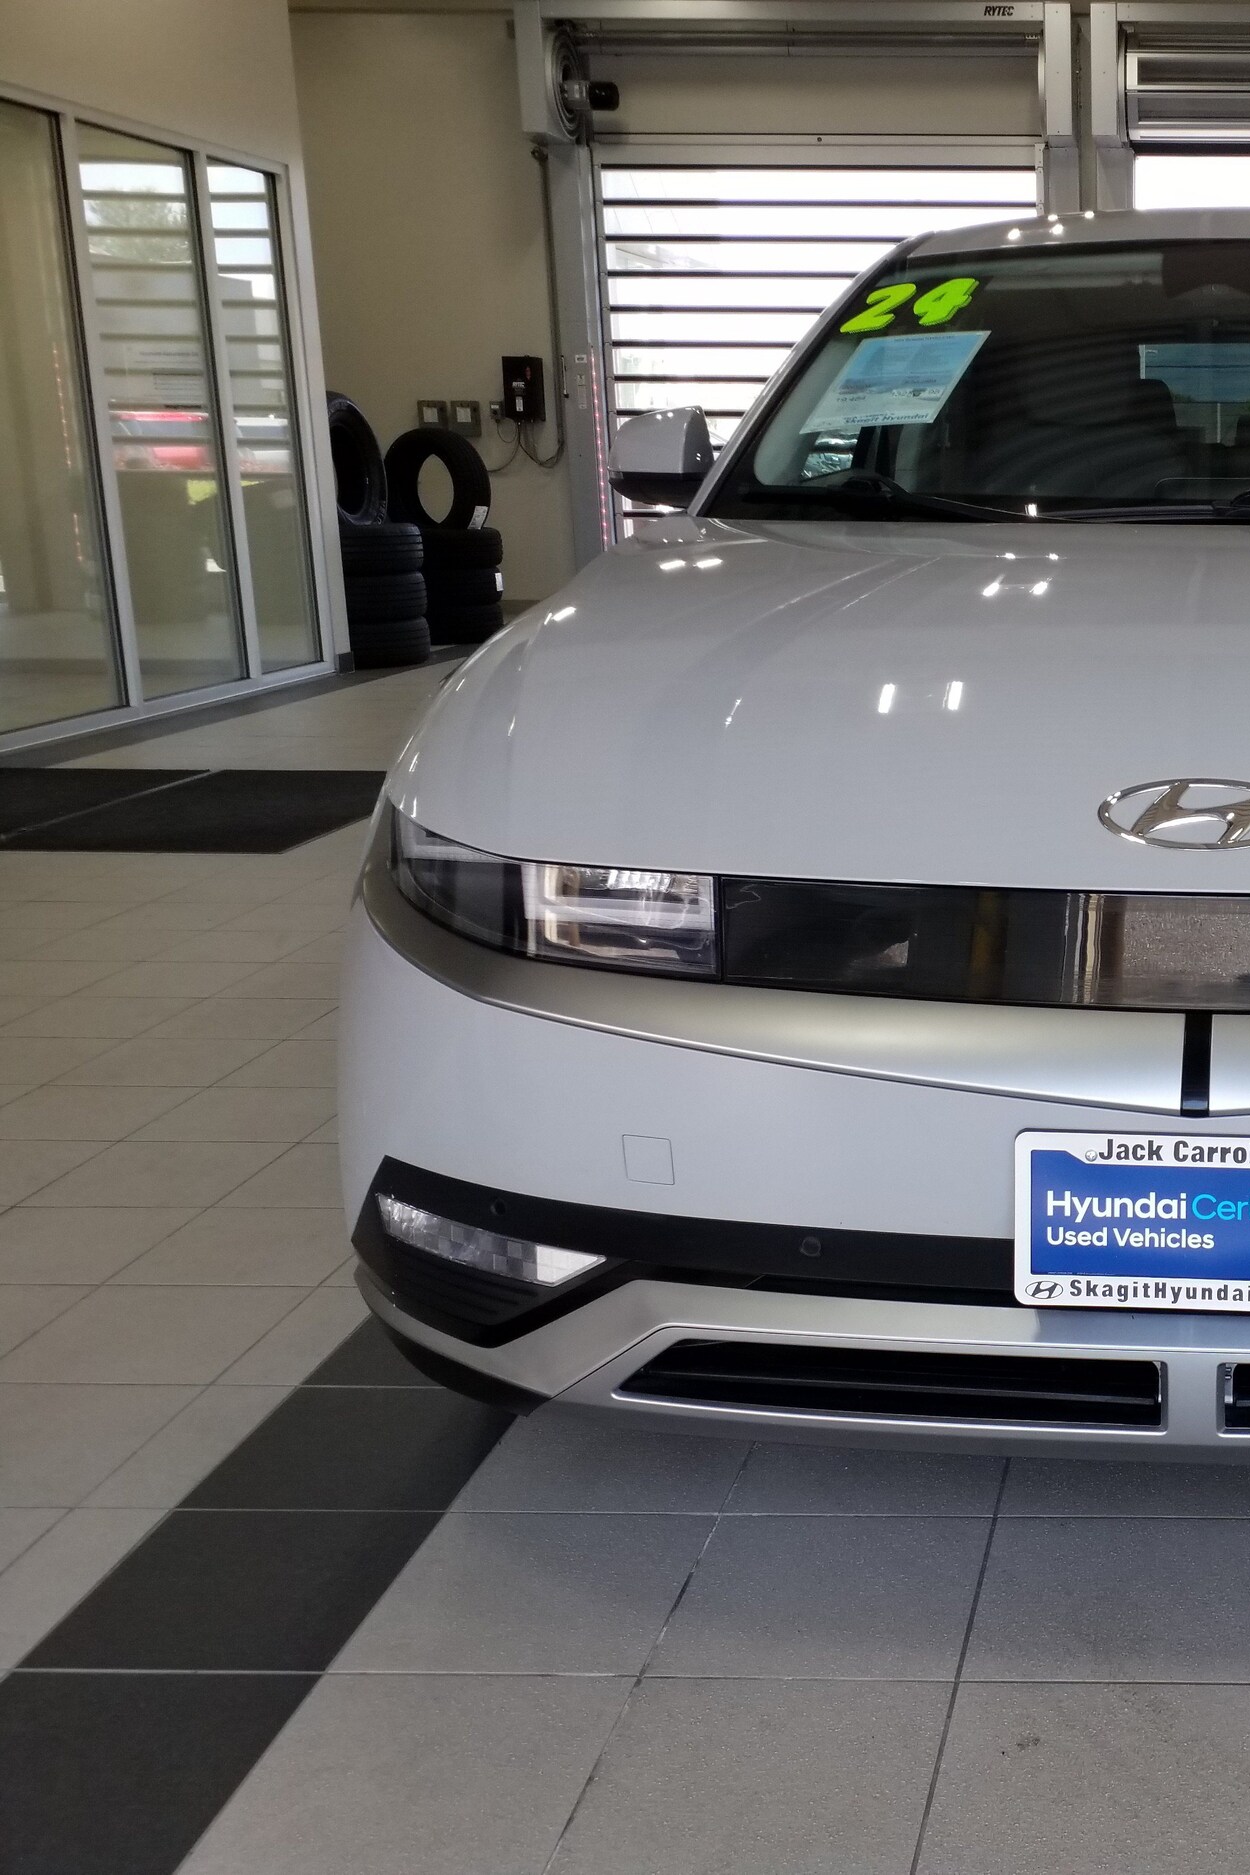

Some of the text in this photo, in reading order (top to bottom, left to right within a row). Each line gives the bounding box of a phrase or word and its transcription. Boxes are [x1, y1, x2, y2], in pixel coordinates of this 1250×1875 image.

[984, 5, 1014, 16] RYTEC
[840, 278, 979, 333] 24
[1098, 1138, 1163, 1163] Jack
[1047, 1190, 1187, 1223] Hyundai
[1047, 1226, 1215, 1249] Used Vehicles
